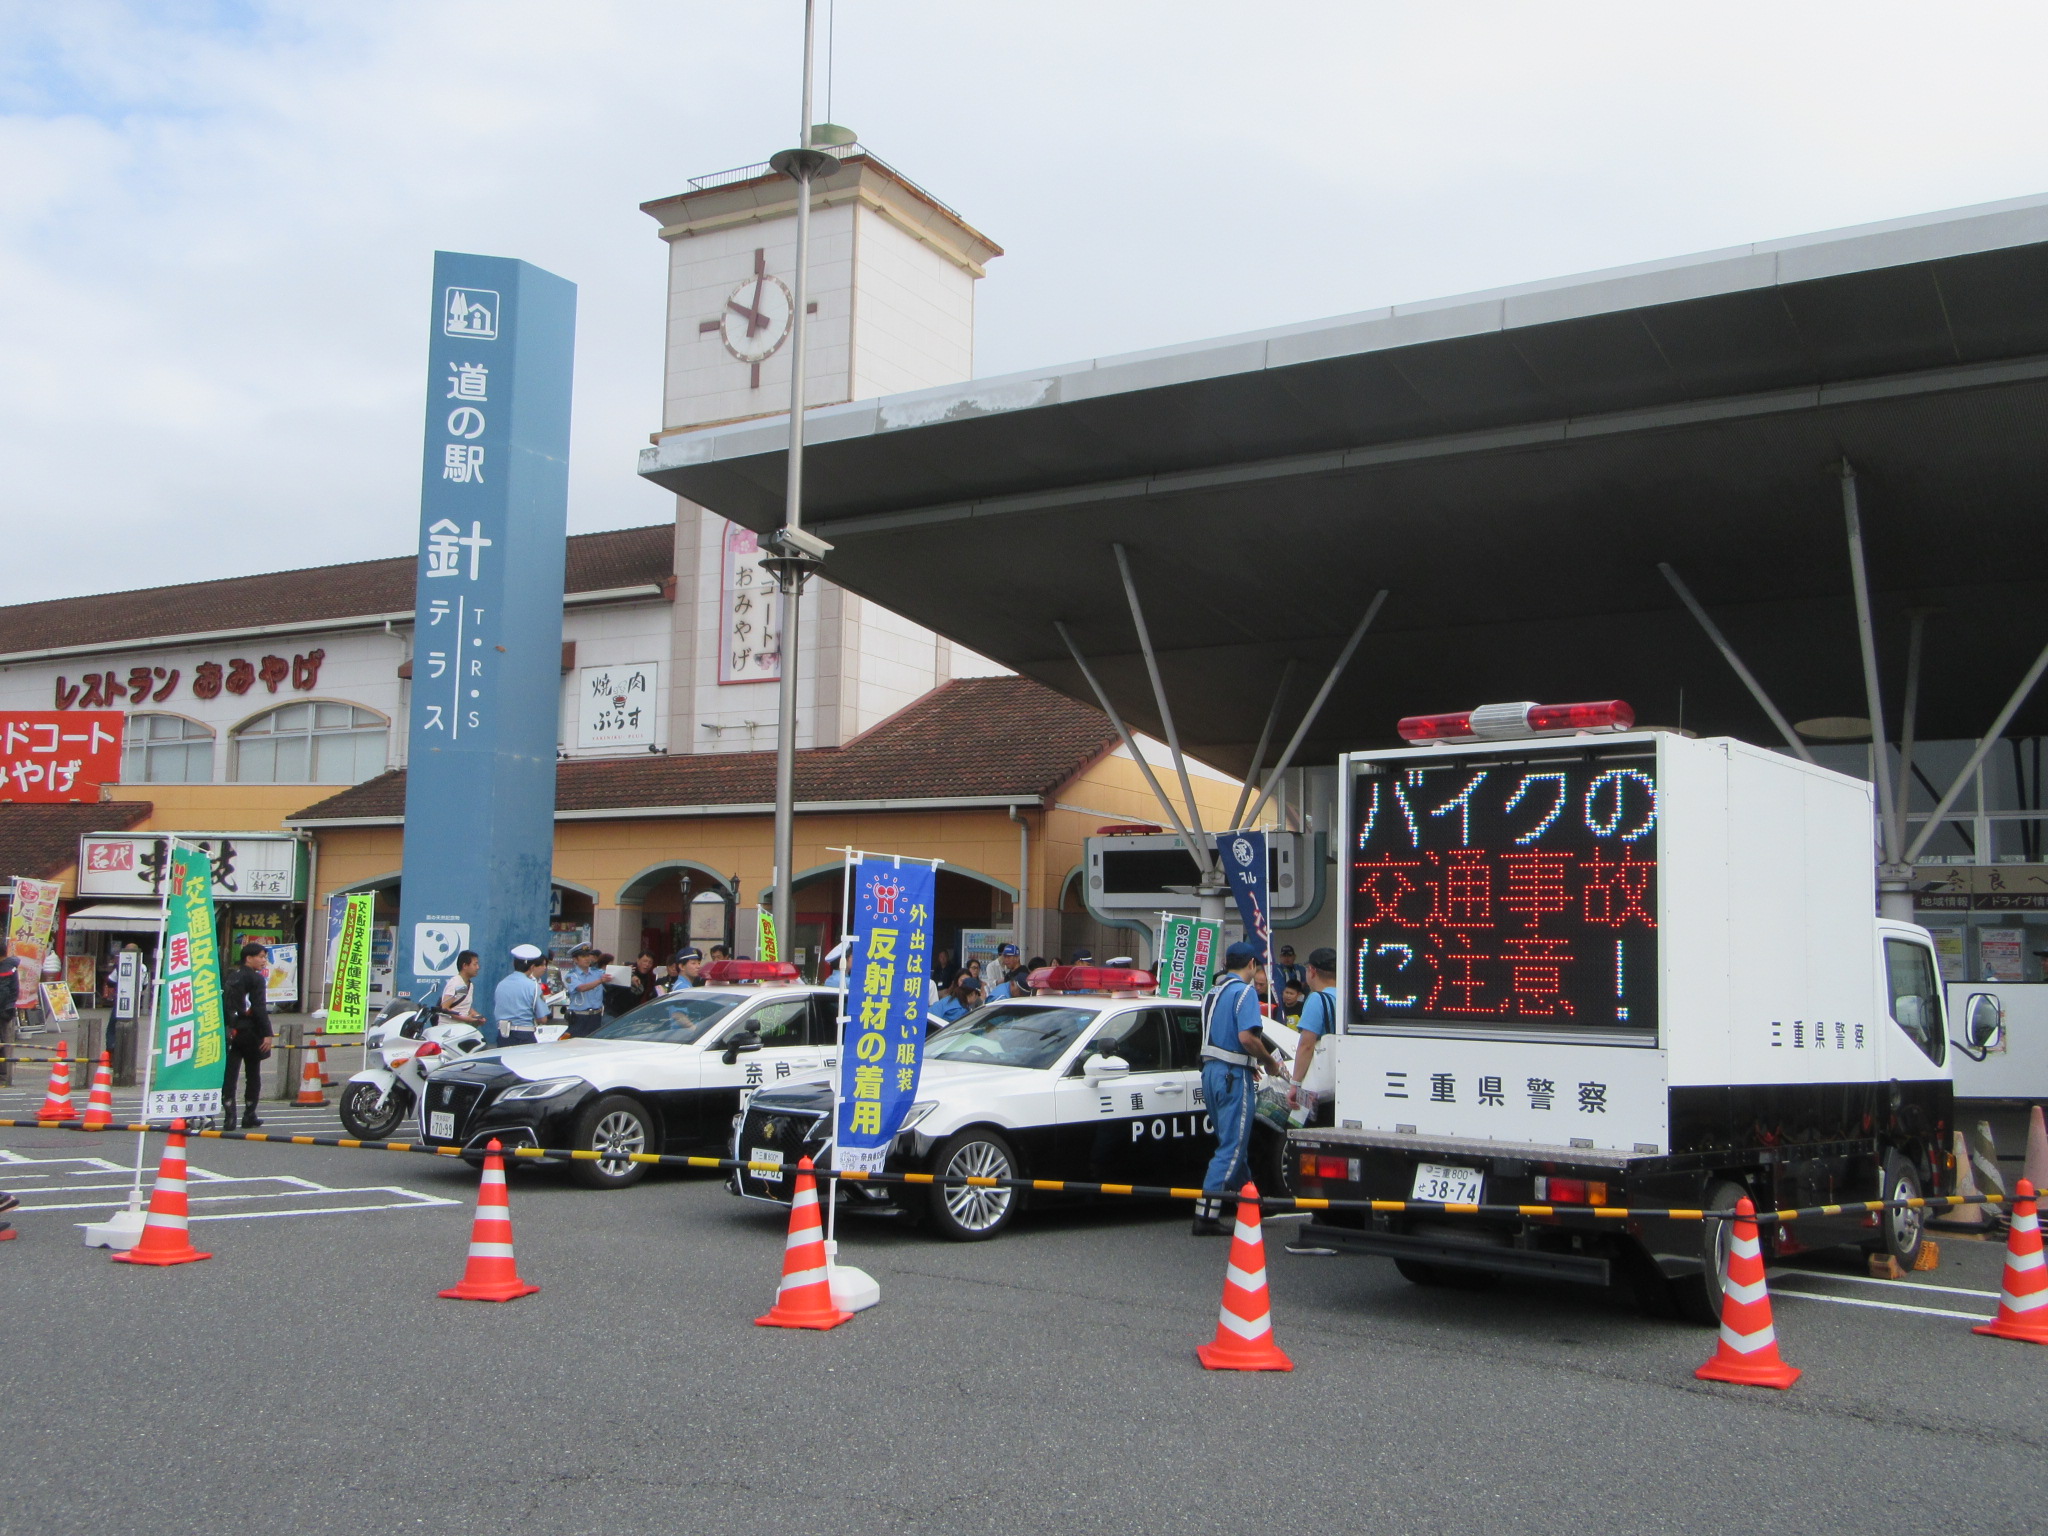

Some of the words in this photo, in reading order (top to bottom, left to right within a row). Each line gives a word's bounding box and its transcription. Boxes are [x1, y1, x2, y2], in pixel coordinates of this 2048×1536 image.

[443, 362, 488, 484] 道の駅
[426, 518, 492, 581] 針
[732, 566, 753, 672] おみやげ
[55, 666, 180, 711] レストラン
[192, 648, 325, 701] おみやげ
[424, 600, 450, 731] テラス
[592, 671, 646, 698] 焼肉
[593, 706, 642, 731] ぷらす
[1358, 768, 1659, 849] バイクの
[252, 880, 280, 892] 針店
[1354, 846, 1658, 927] 交通事故
[169, 937, 193, 1060] 実施中
[185, 876, 221, 1069] 交通安全運動
[895, 904, 928, 1093] 外出は明るい服装
[850, 928, 898, 1135] 反射材の着用
[1771, 1020, 1864, 1049] 三重県警察
[1384, 1071, 1607, 1114] 三重県警察
[1427, 1179, 1477, 1202] 38-74
